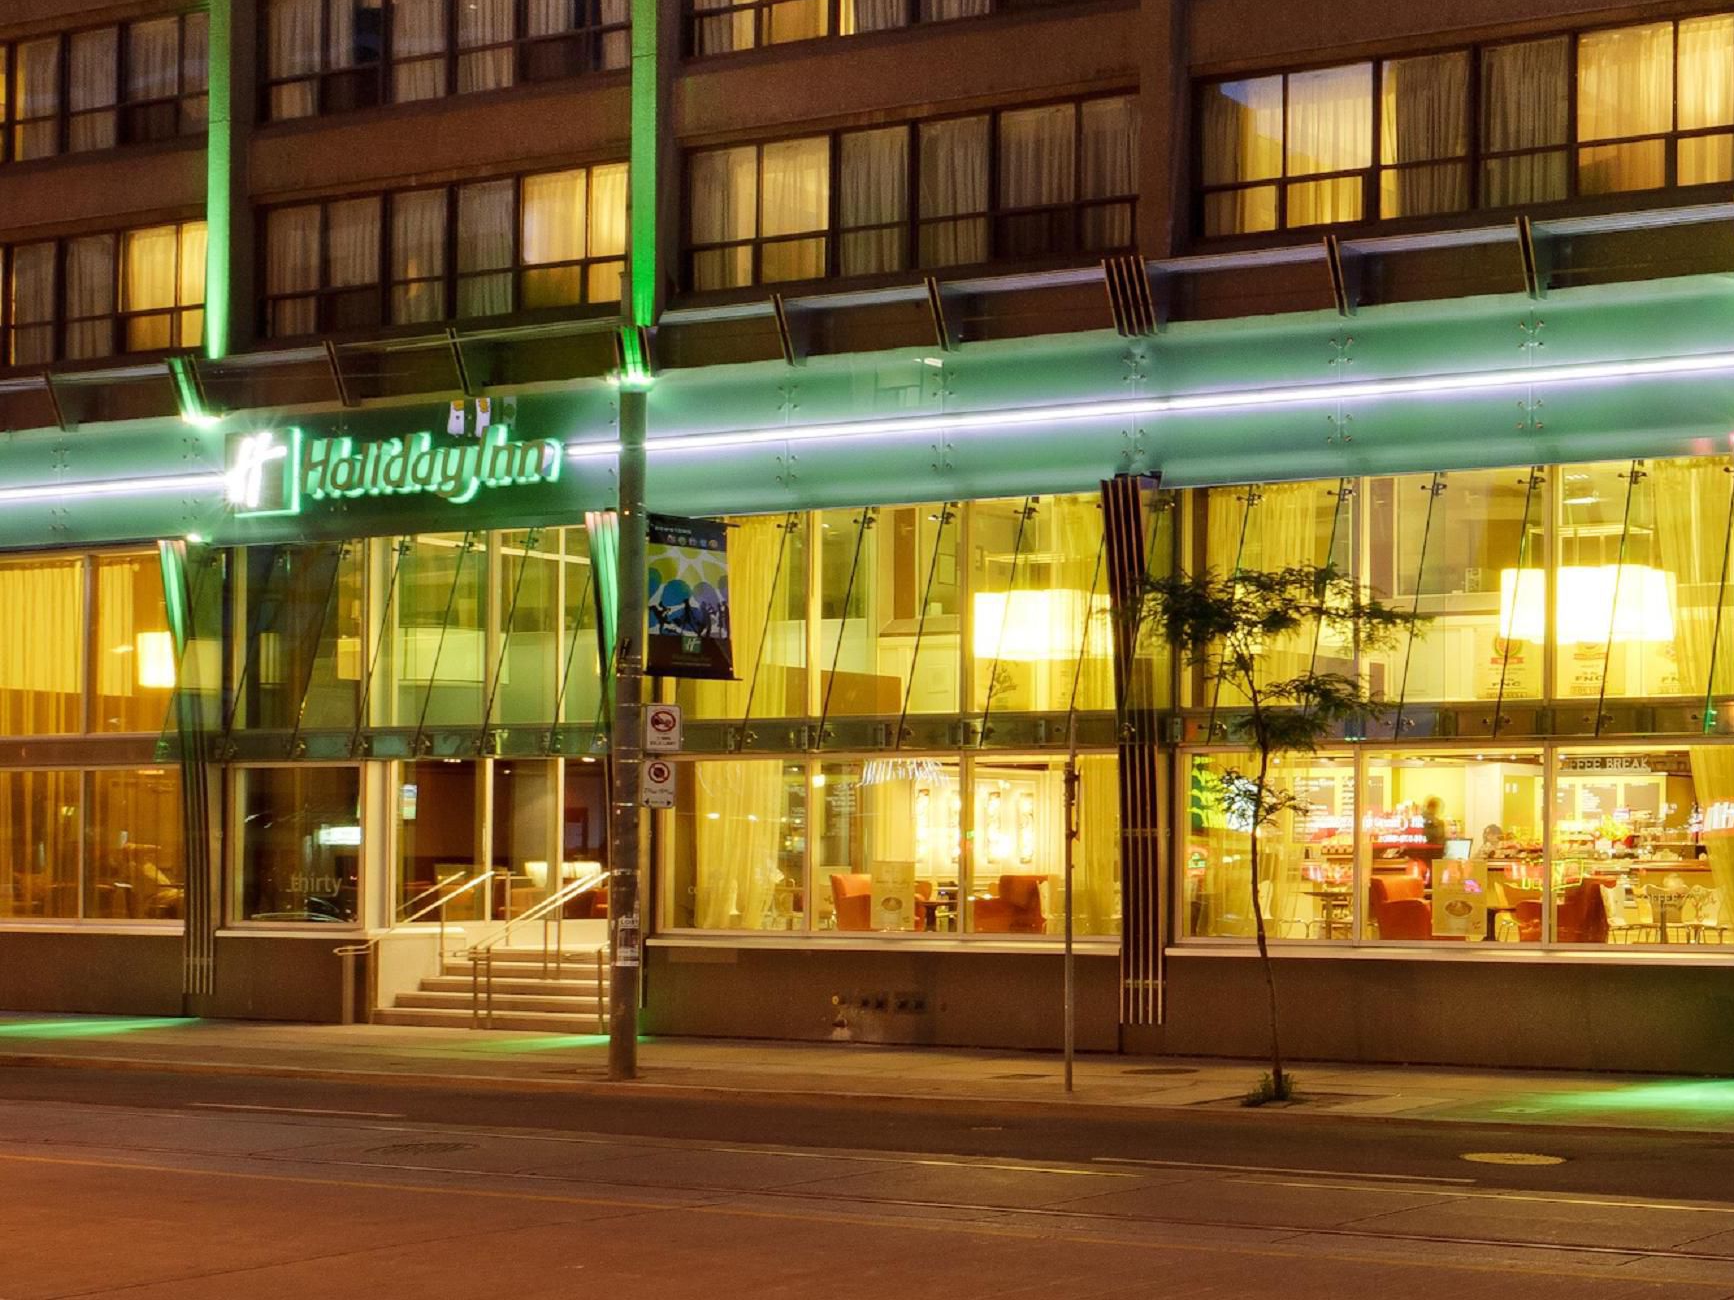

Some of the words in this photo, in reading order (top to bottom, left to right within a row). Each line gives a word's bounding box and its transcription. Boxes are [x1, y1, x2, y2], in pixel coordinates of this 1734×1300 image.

[304, 431, 480, 504] Holiday
[477, 424, 561, 486] Inn
[1557, 758, 1601, 770] FFEE
[1606, 756, 1650, 769] BREAK
[291, 871, 342, 897] thirty
